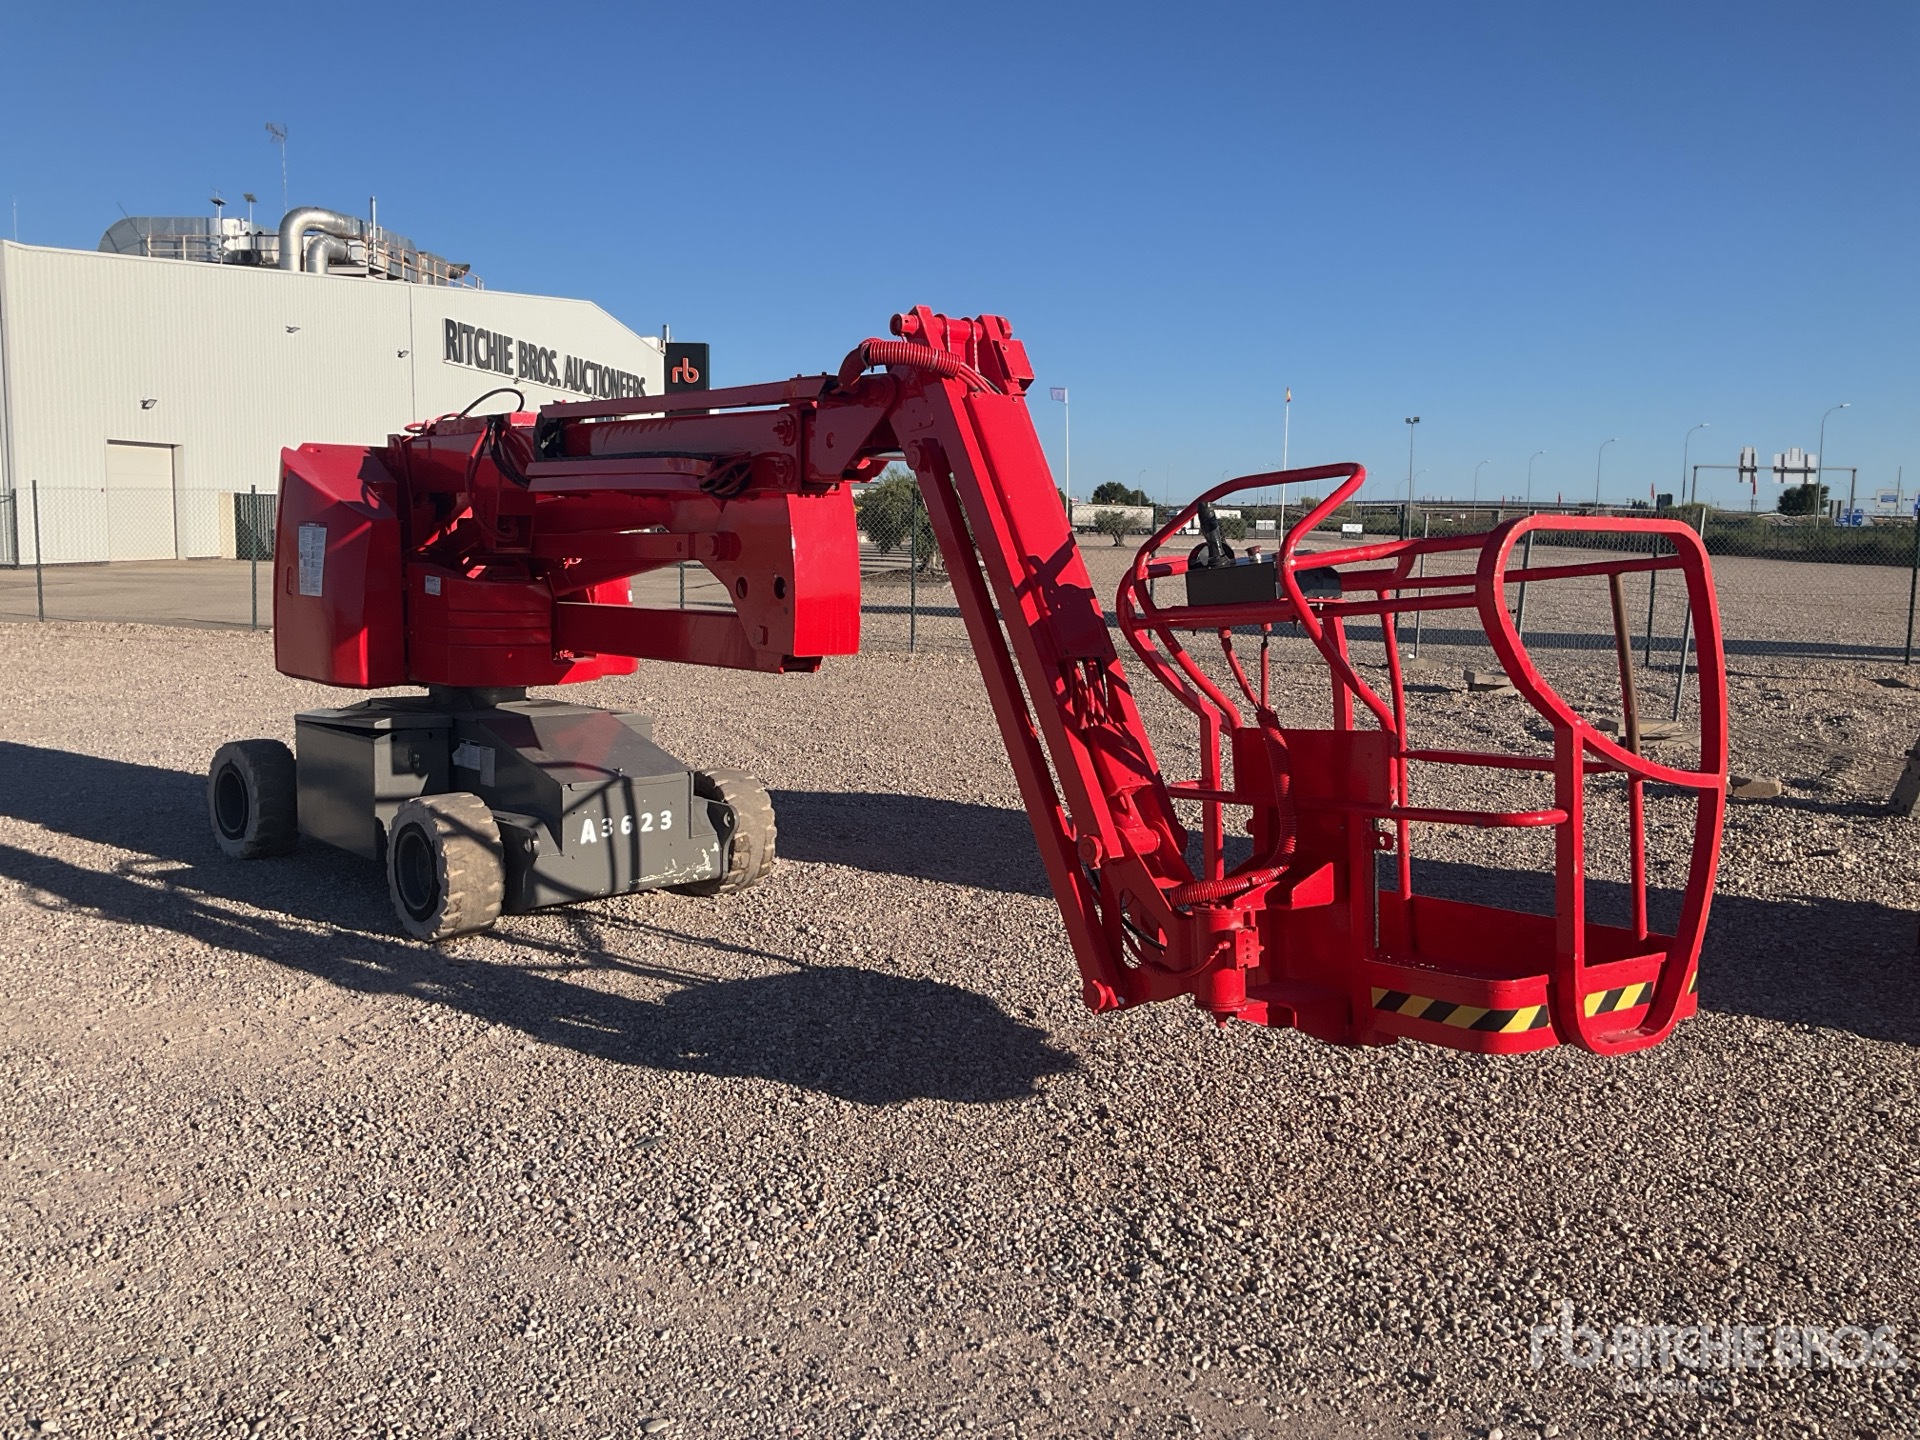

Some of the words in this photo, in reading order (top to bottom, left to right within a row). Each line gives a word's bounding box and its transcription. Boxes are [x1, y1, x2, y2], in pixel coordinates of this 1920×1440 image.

[444, 318, 514, 376] RITCHIE
[516, 339, 561, 387] BROS.
[563, 354, 647, 399] AUCTIONEERS
[671, 357, 699, 384] rb
[580, 810, 673, 845] A3623
